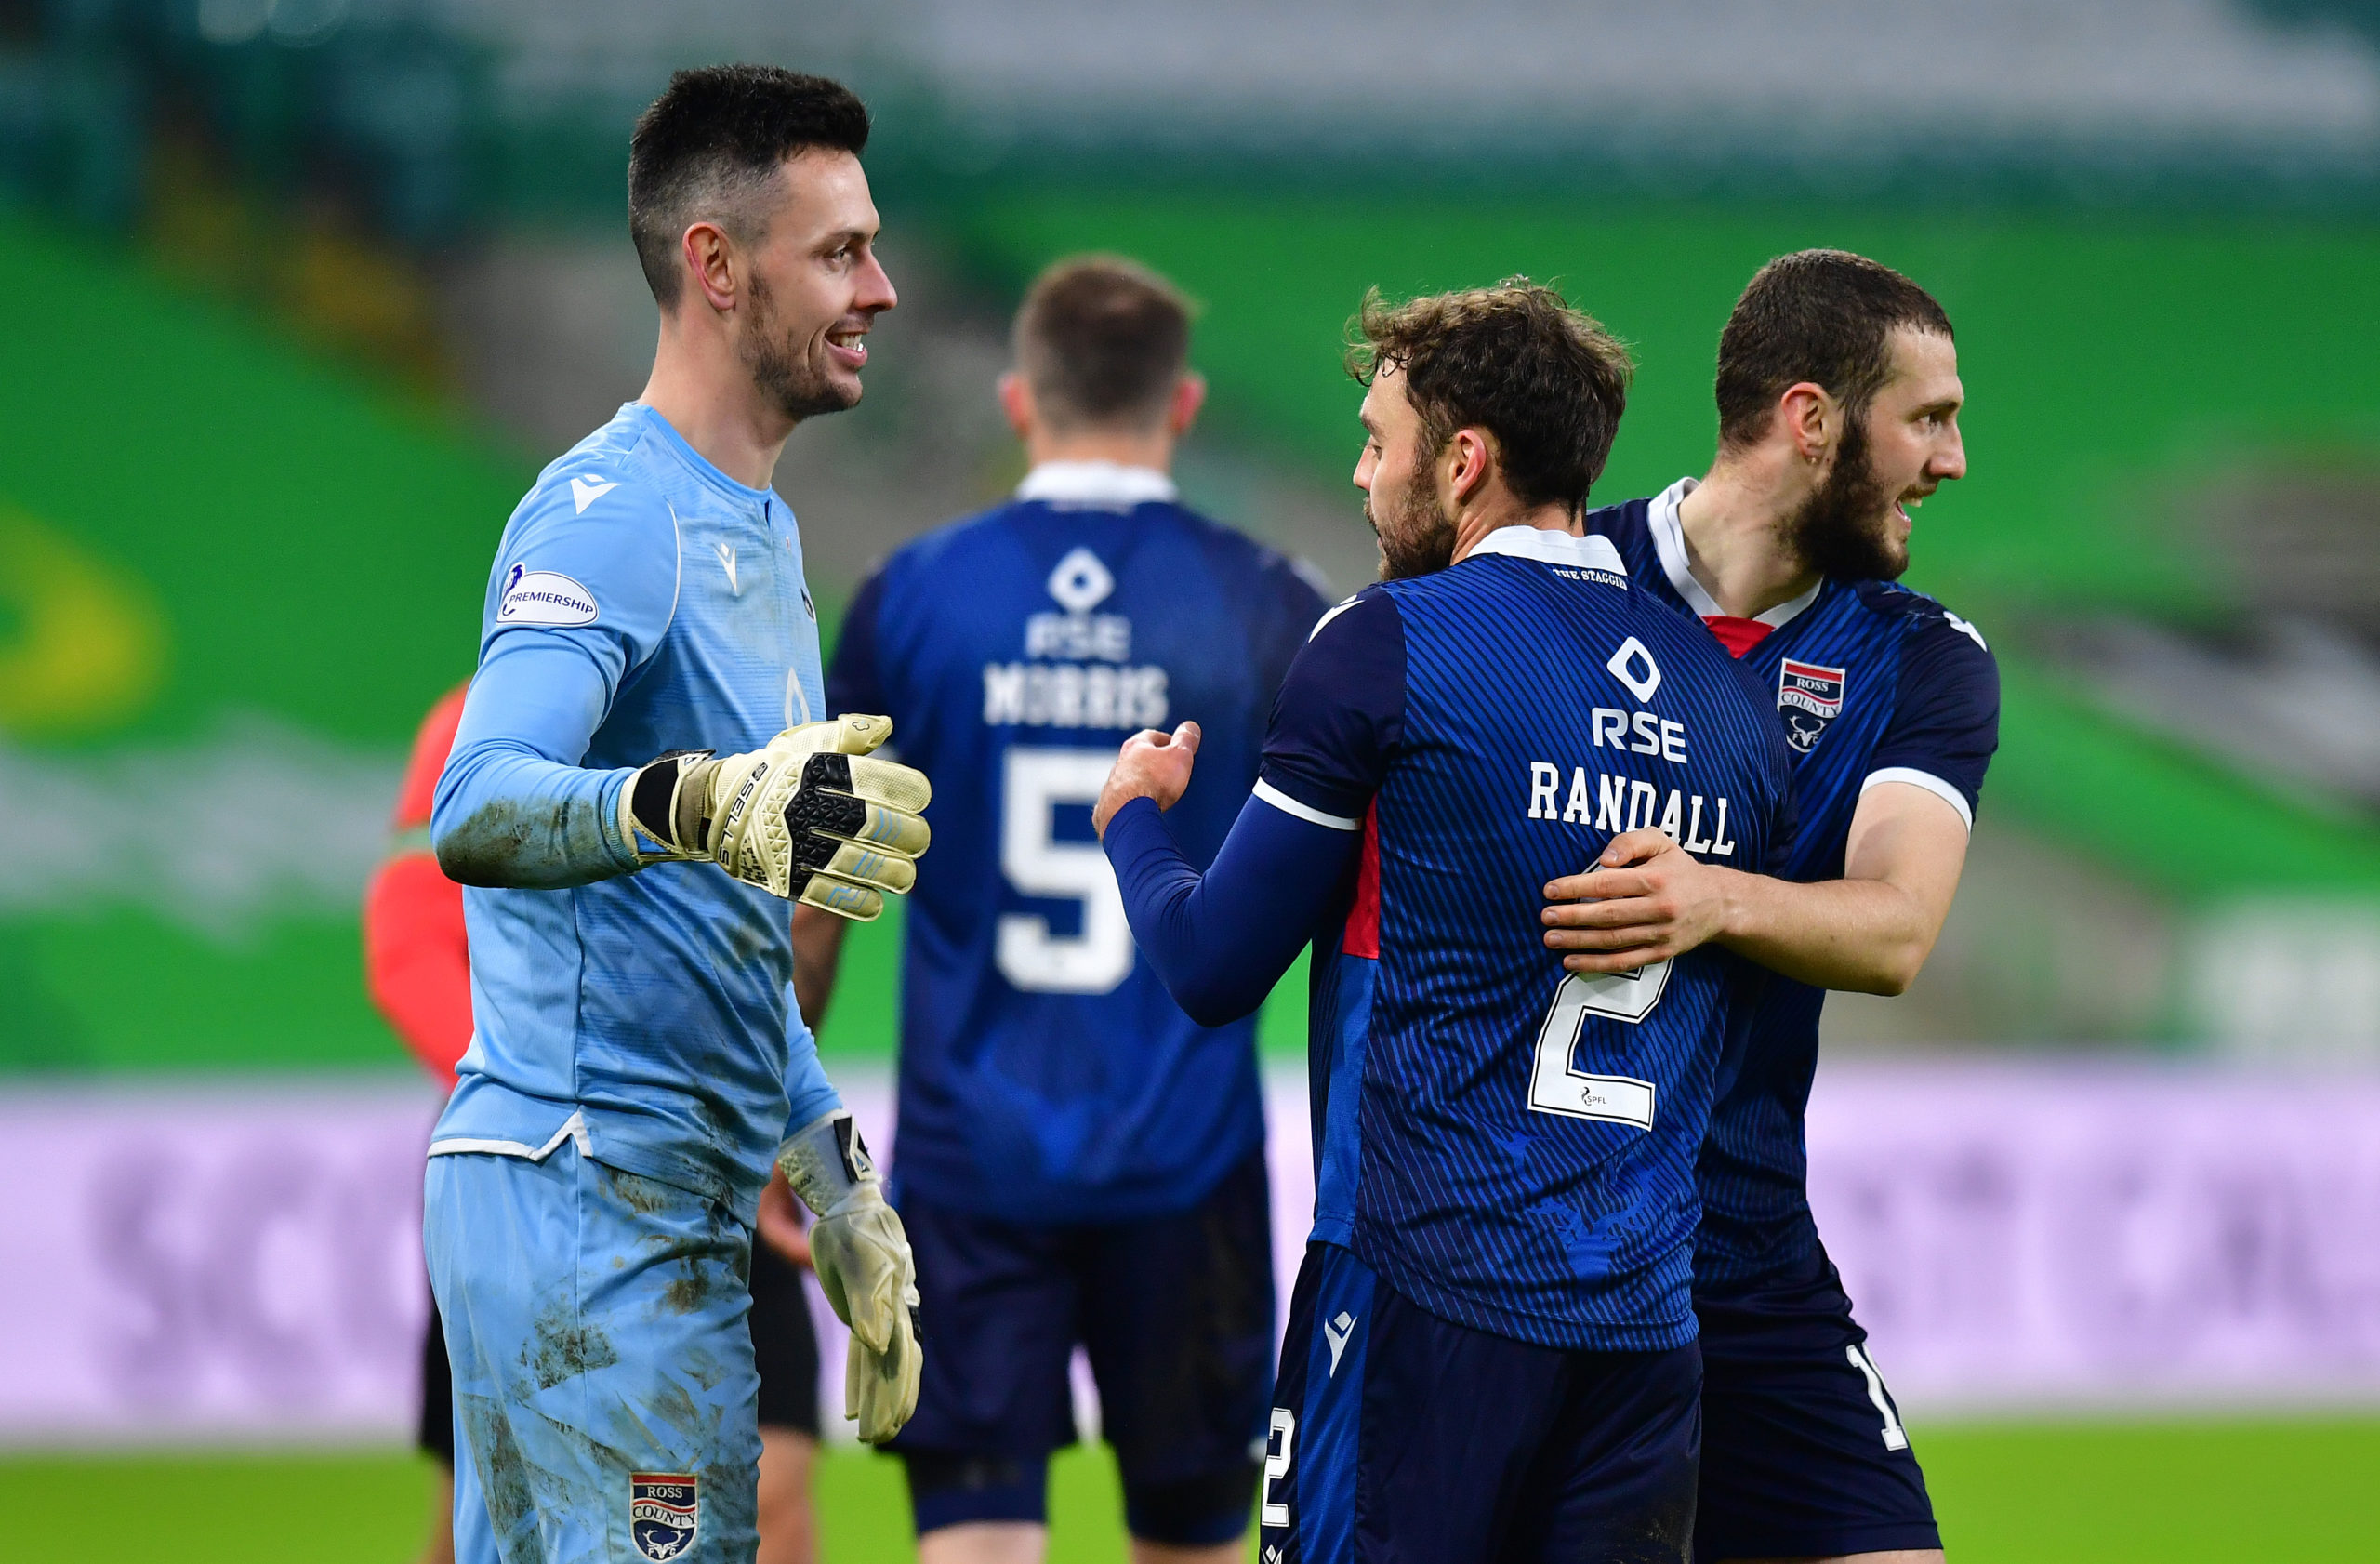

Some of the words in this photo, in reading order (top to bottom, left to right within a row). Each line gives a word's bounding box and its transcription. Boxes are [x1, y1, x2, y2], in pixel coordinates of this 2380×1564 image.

[509, 591, 594, 614] PREMIERSHIP
[1552, 568, 1580, 580] THE
[983, 661, 1170, 729] MORRIS
[1781, 693, 1840, 716] COUNTY
[1796, 677, 1829, 692] ROSS
[1591, 707, 1687, 764] RSE
[719, 779, 755, 866] SELLS
[1527, 761, 1735, 855] RANDALL
[996, 747, 1135, 995] 5
[1527, 857, 1674, 1132] 2
[1587, 1095, 1607, 1105] SPFL
[1845, 1341, 1909, 1451] 1
[647, 1486, 683, 1499] ROSS
[1261, 1407, 1295, 1527] 2
[633, 1505, 695, 1526] COUNTY
